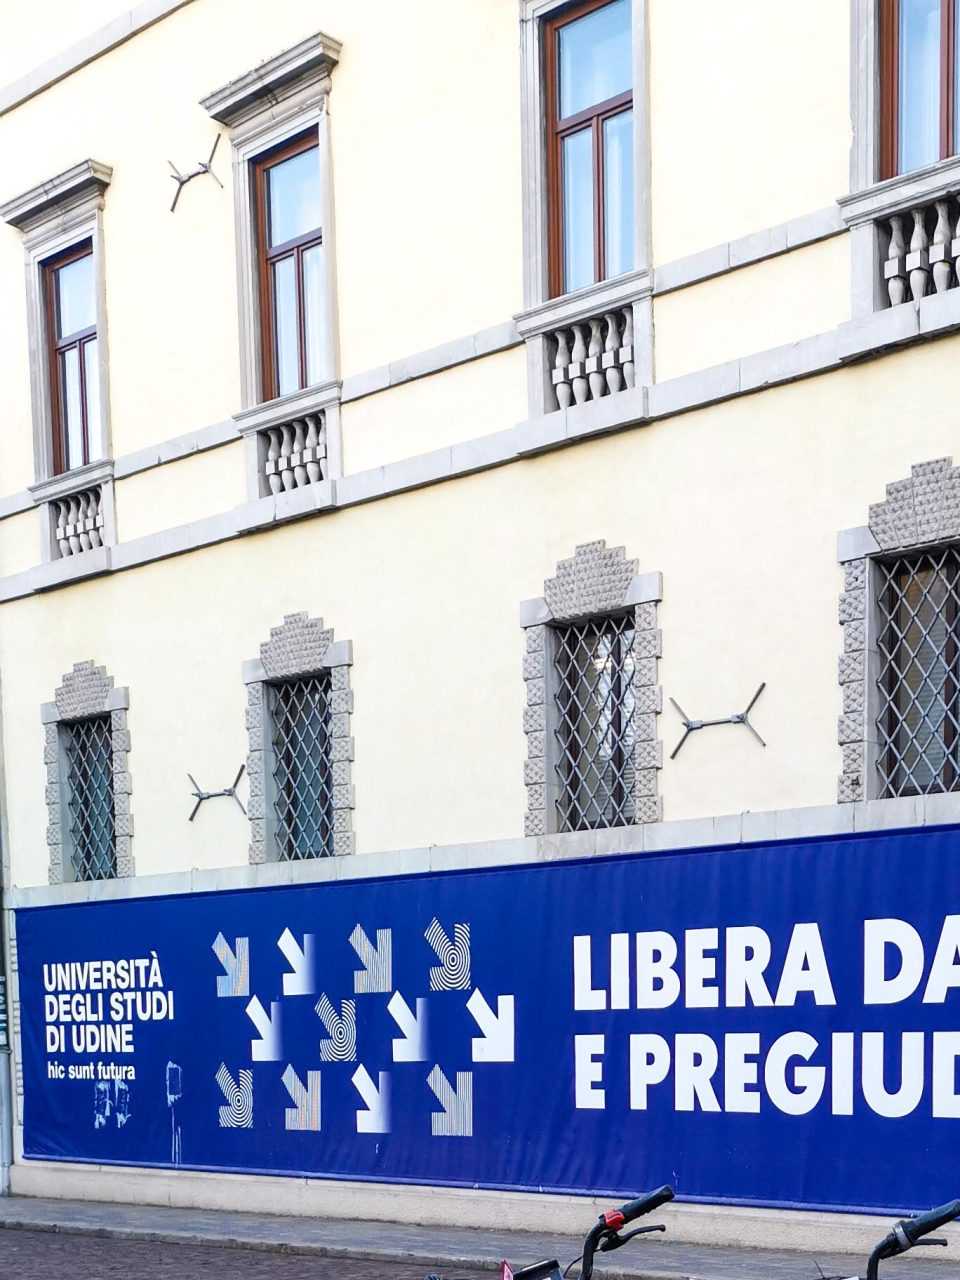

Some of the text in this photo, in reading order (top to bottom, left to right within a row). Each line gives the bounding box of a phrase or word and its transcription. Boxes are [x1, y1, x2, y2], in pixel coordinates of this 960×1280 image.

[43, 950, 163, 992] UNIVERSITÀ
[573, 922, 837, 1011] LIBERA
[45, 992, 104, 1023] DEGLI
[110, 990, 174, 1021] STUDI
[46, 1023, 135, 1053] DI UDINE
[47, 1061, 136, 1080] hic sunt futura
[574, 1034, 605, 1109] E
